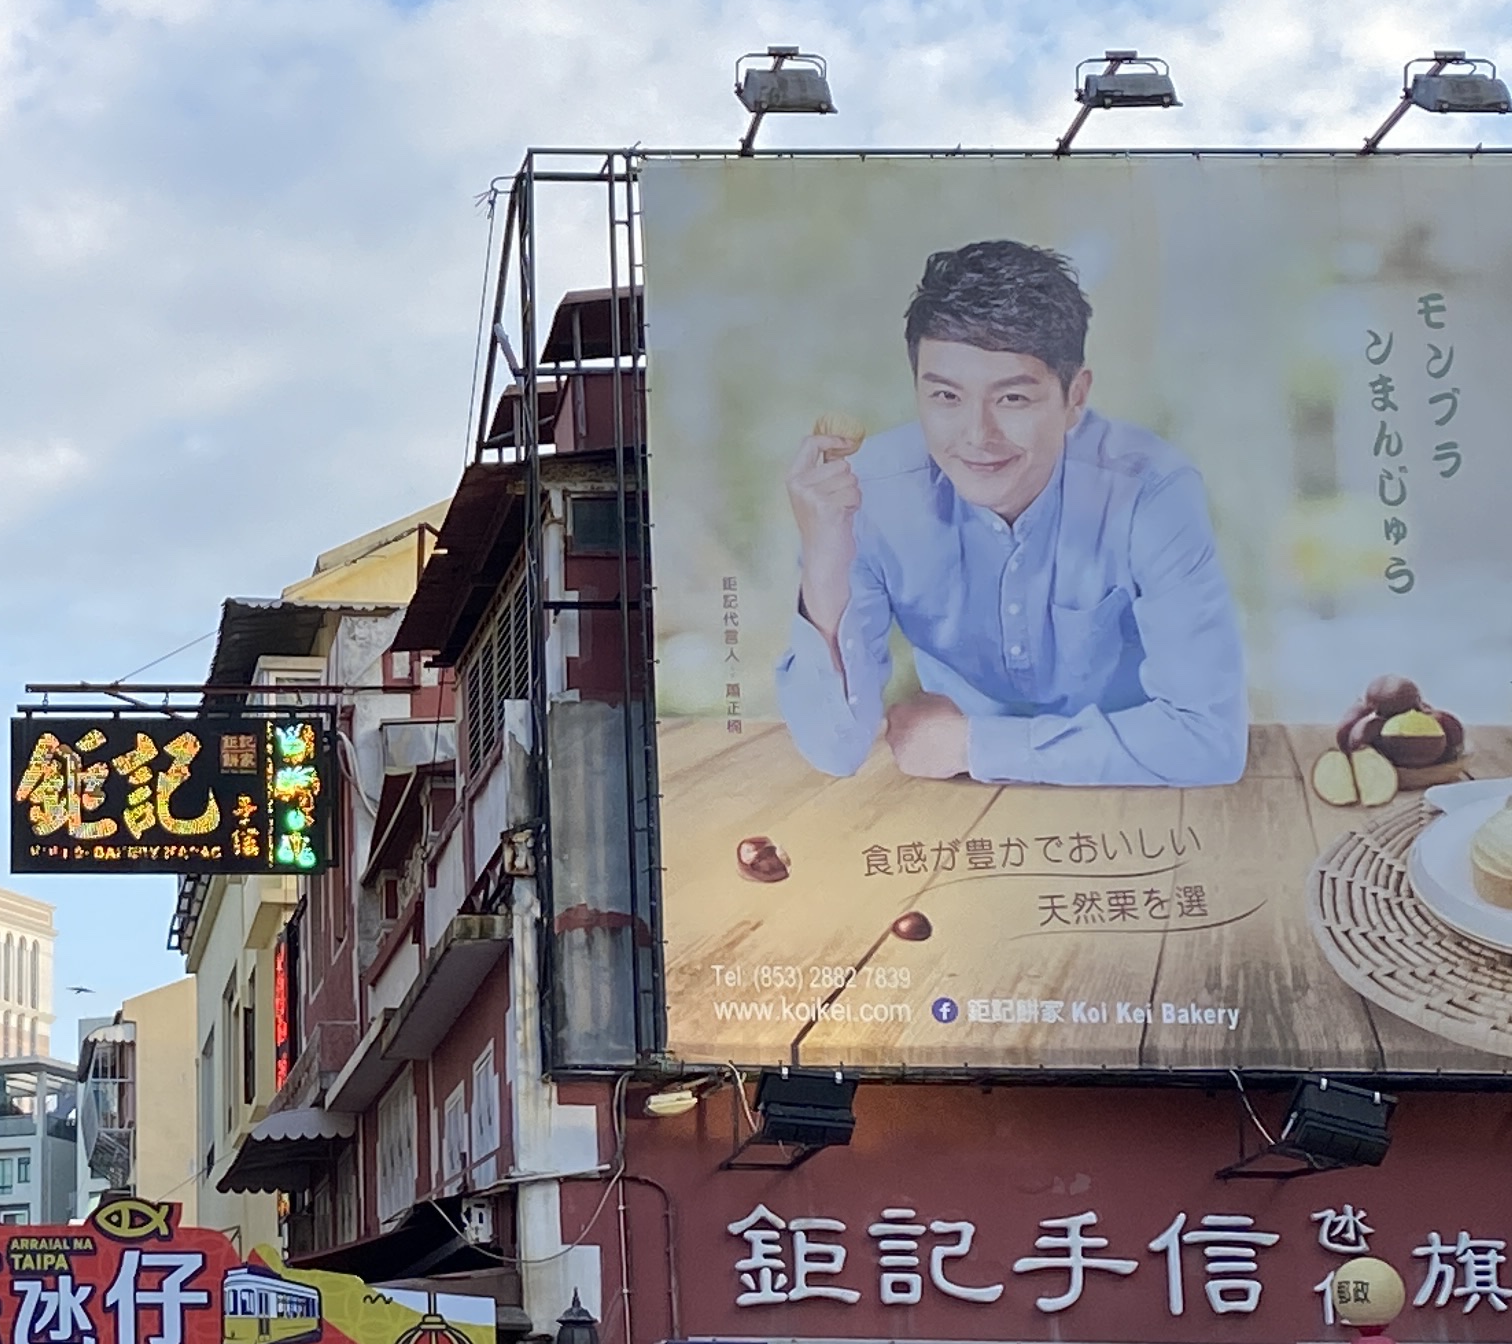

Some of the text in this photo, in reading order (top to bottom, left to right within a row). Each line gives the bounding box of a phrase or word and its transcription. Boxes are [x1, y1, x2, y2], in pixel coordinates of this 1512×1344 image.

[753, 965, 804, 993] (853)
[809, 966, 857, 989] 2882
[865, 966, 911, 988] 7839
[713, 996, 912, 1022] www.koikei.com
[1072, 1002, 1107, 1024] Koi
[1116, 1002, 1153, 1024] Kei
[1162, 1002, 1239, 1030] Bakery
[10, 1238, 94, 1251] ARRAIAL NA
[10, 1253, 69, 1271] TAIPA
[727, 1204, 1281, 1317] 鉅記手信
